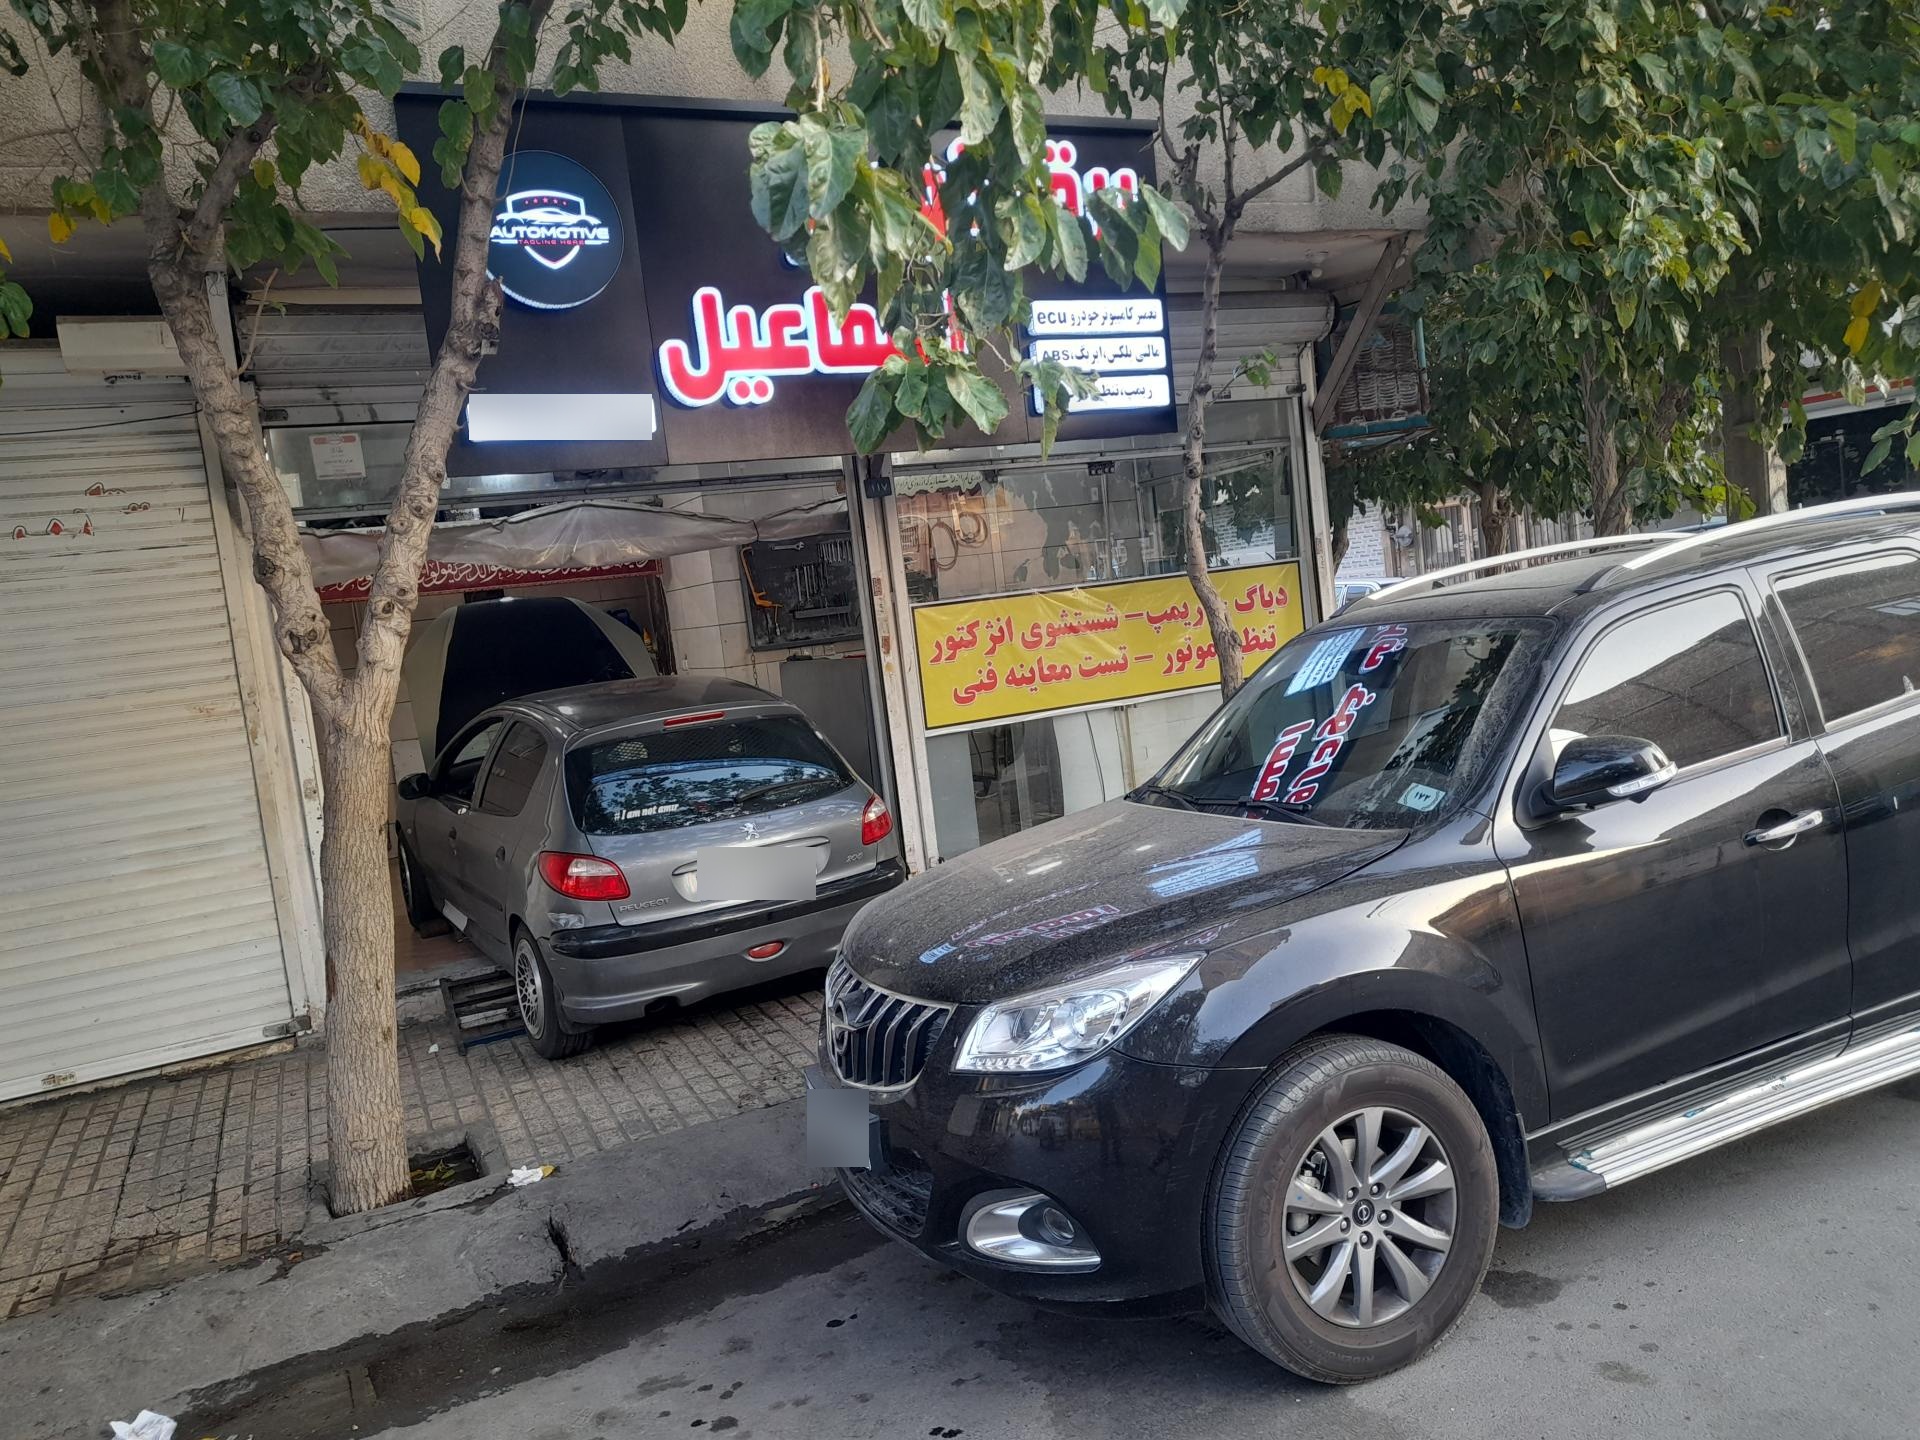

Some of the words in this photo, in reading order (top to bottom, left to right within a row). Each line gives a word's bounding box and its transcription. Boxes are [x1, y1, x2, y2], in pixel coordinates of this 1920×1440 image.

[490, 226, 609, 239] AUTOMOTIVE
[1036, 311, 1067, 325] ecu
[1042, 349, 1069, 361] ABS
[1234, 584, 1288, 614] دیاگ
[1020, 604, 1120, 650] شستشوی
[1078, 645, 1129, 679] تست
[953, 660, 998, 706] فنی
[1005, 655, 1072, 695] معاینه
[626, 809, 641, 819] am
[641, 805, 657, 816] not
[619, 897, 670, 912] PEUGEOT
